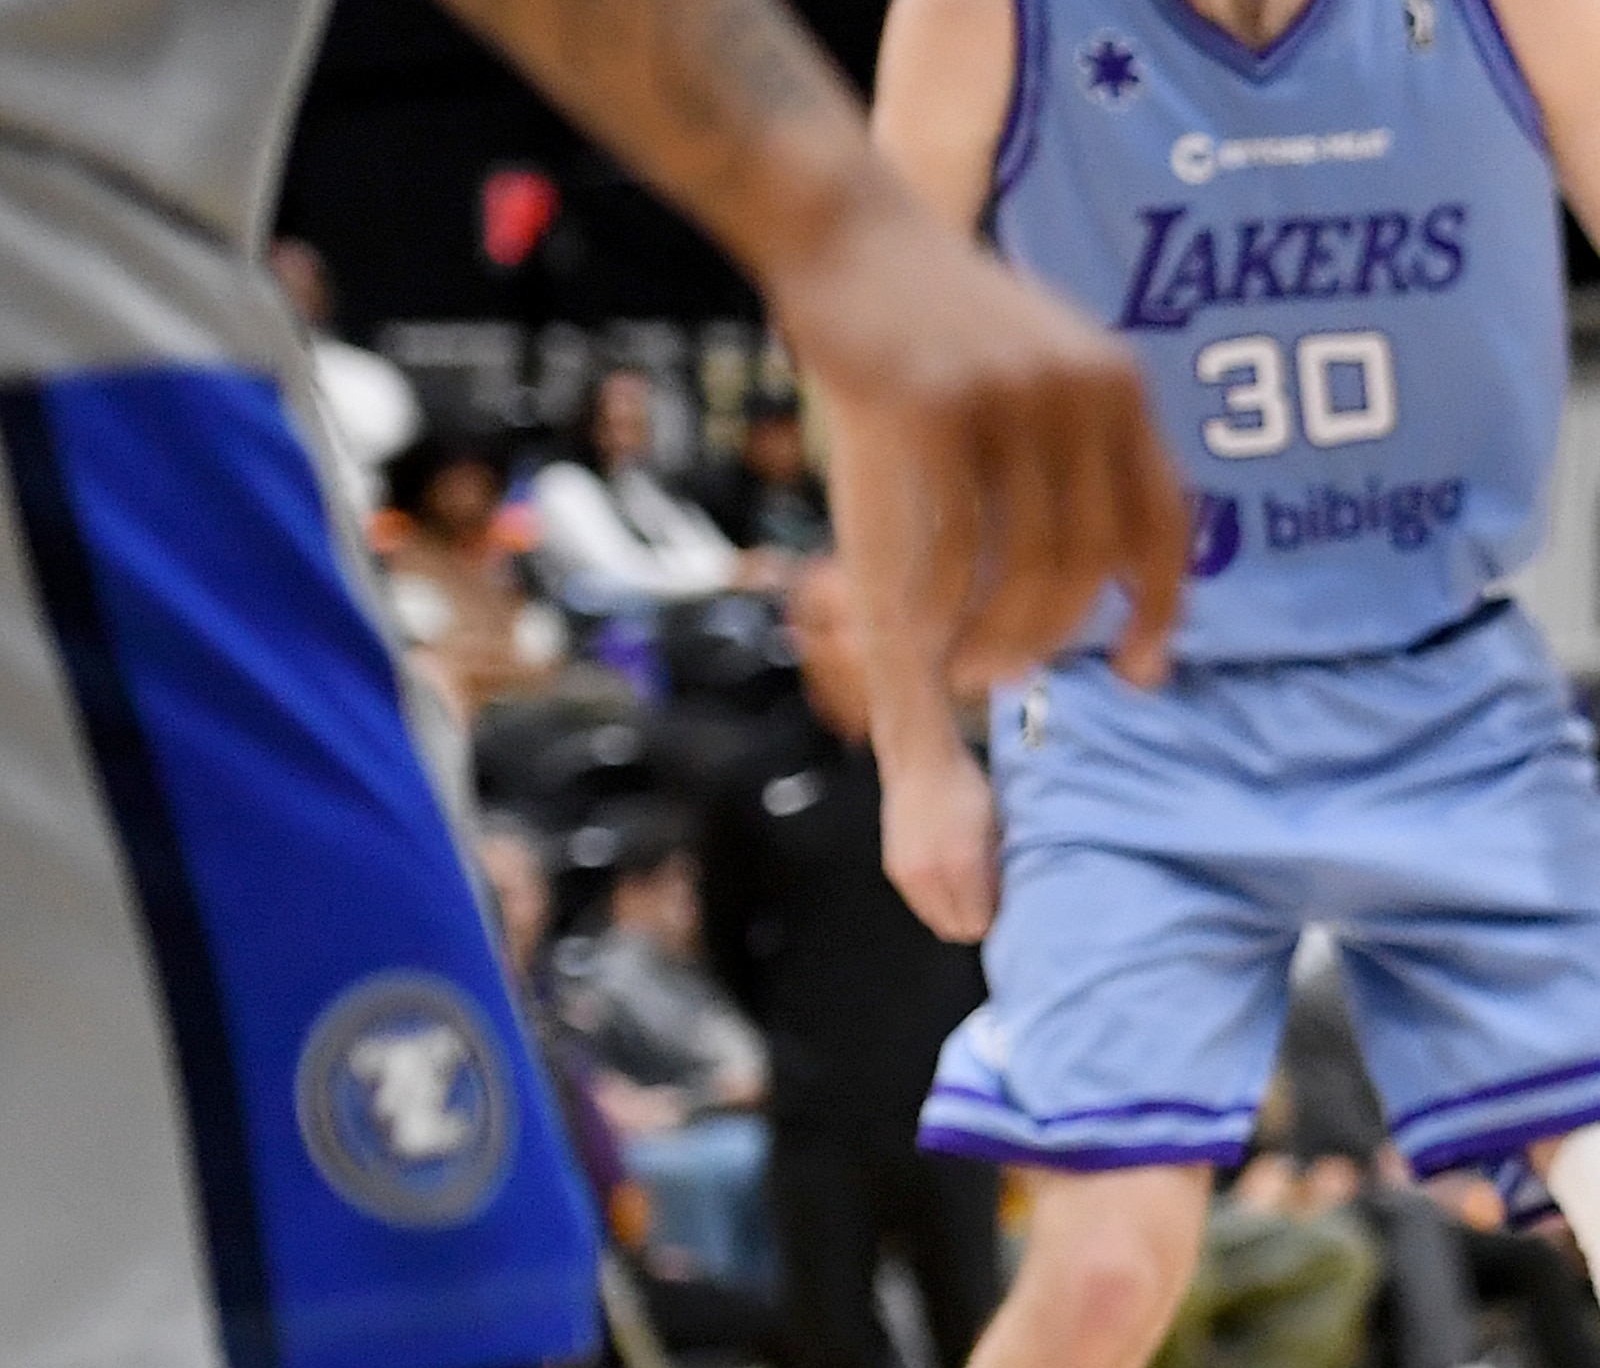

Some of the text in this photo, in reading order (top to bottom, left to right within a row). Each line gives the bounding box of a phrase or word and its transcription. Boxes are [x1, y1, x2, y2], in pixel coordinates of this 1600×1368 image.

[1119, 202, 1469, 330] LAKERS
[1196, 330, 1397, 459] 30
[1262, 476, 1470, 552] bibigo
